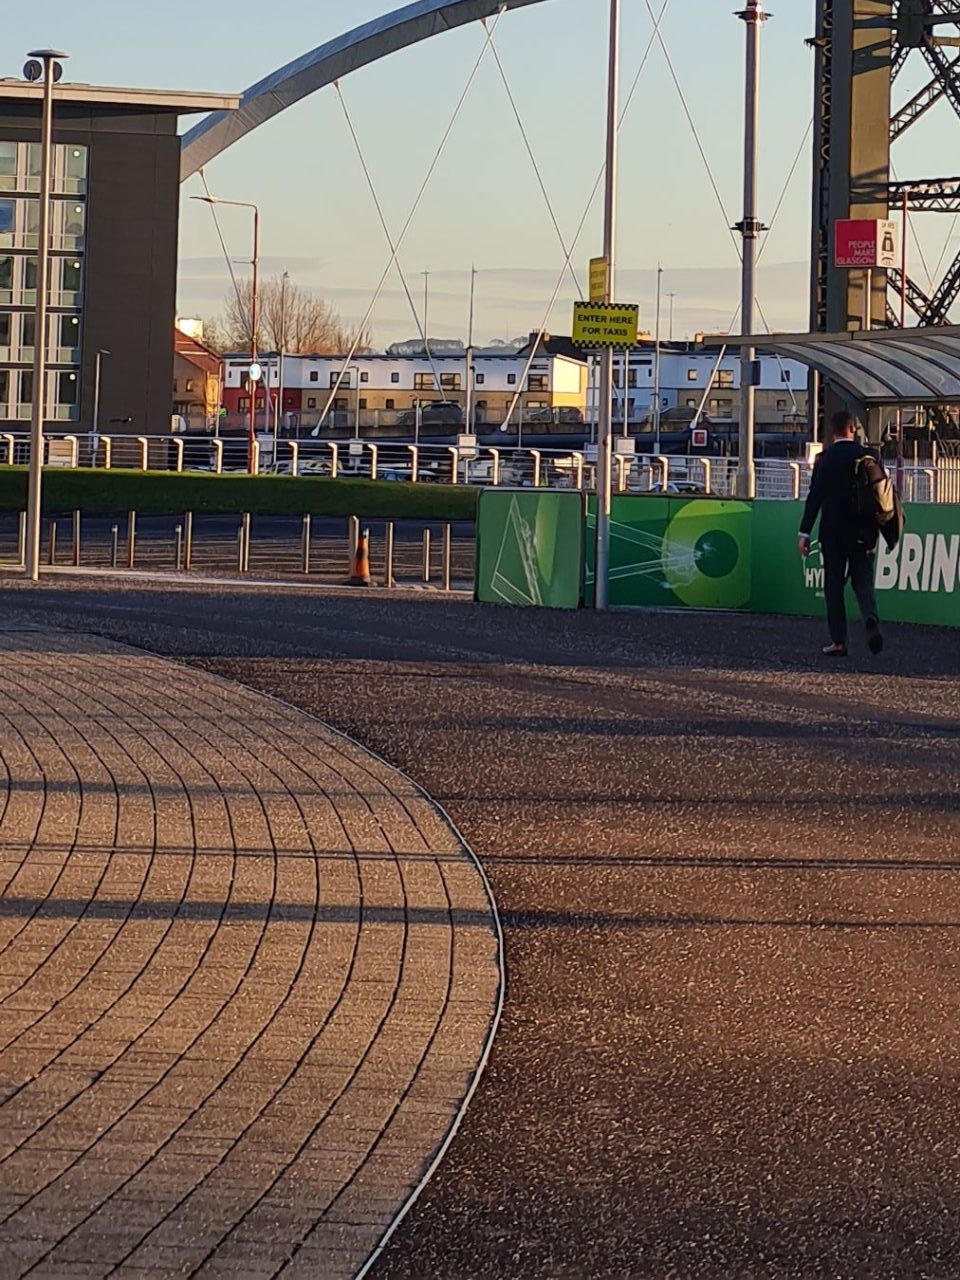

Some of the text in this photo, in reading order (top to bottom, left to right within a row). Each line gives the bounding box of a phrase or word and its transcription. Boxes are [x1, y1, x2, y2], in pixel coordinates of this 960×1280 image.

[848, 241, 875, 249] PEOPLE
[837, 257, 875, 265] GLASGOW
[578, 314, 633, 324] ENTER HERE
[603, 327, 628, 336] TAXIS
